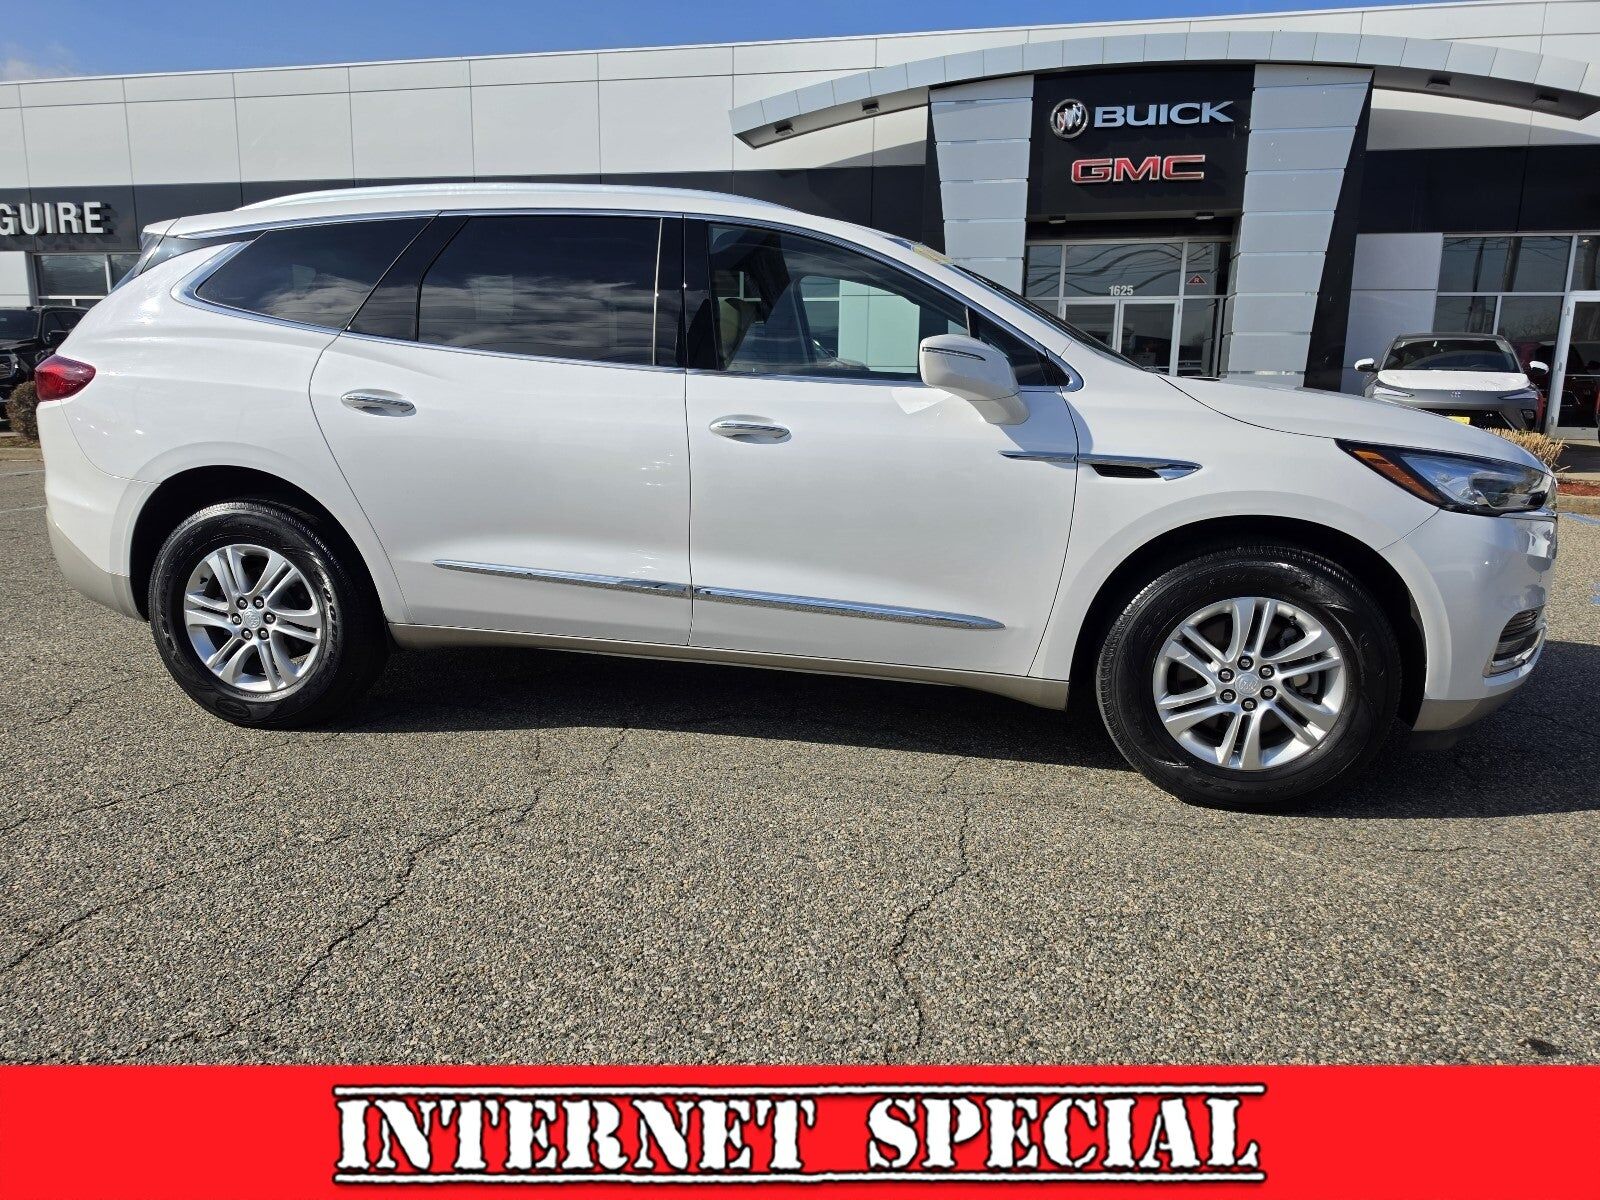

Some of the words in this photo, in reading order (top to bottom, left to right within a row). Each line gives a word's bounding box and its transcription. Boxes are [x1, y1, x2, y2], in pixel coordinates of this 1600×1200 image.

[1094, 100, 1234, 128] BUICK
[1071, 154, 1206, 183] GMC
[0, 201, 104, 235] GUIRE
[1108, 285, 1134, 296] 1625
